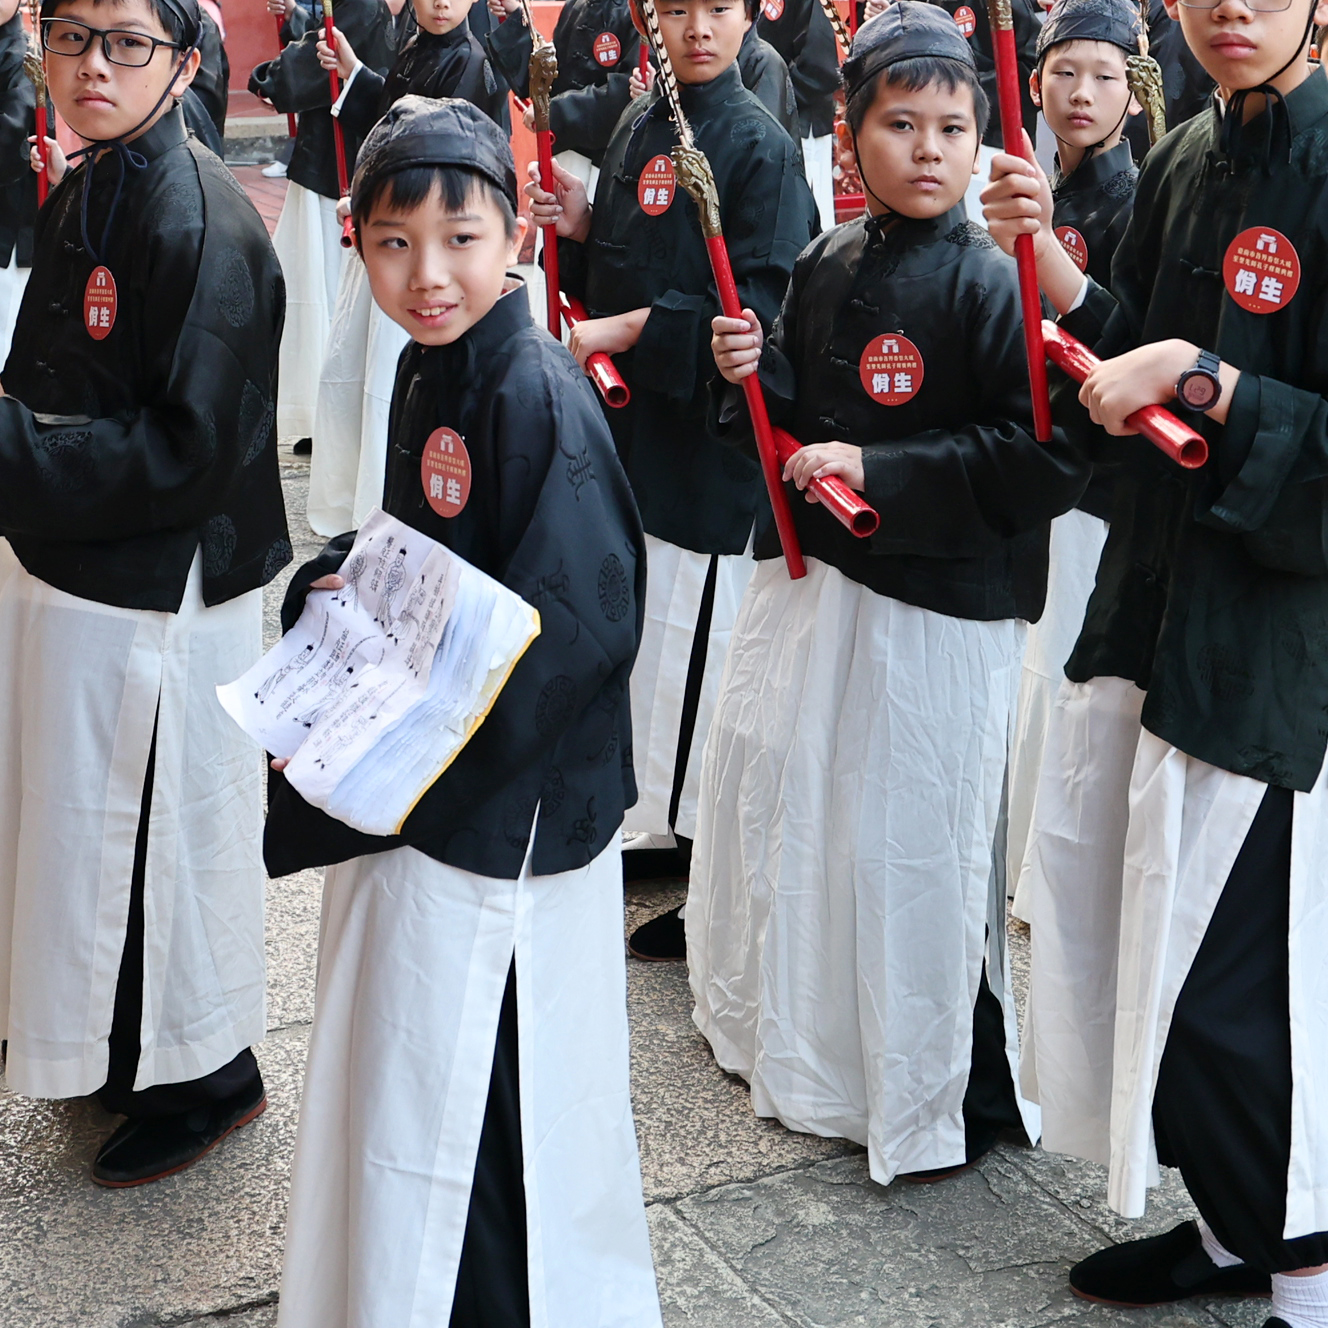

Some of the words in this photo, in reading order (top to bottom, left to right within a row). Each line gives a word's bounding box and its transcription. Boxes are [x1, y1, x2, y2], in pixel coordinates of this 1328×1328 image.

[1234, 268, 1284, 304] 佾生
[872, 372, 913, 394] 佾生
[429, 472, 461, 505] 佾生
